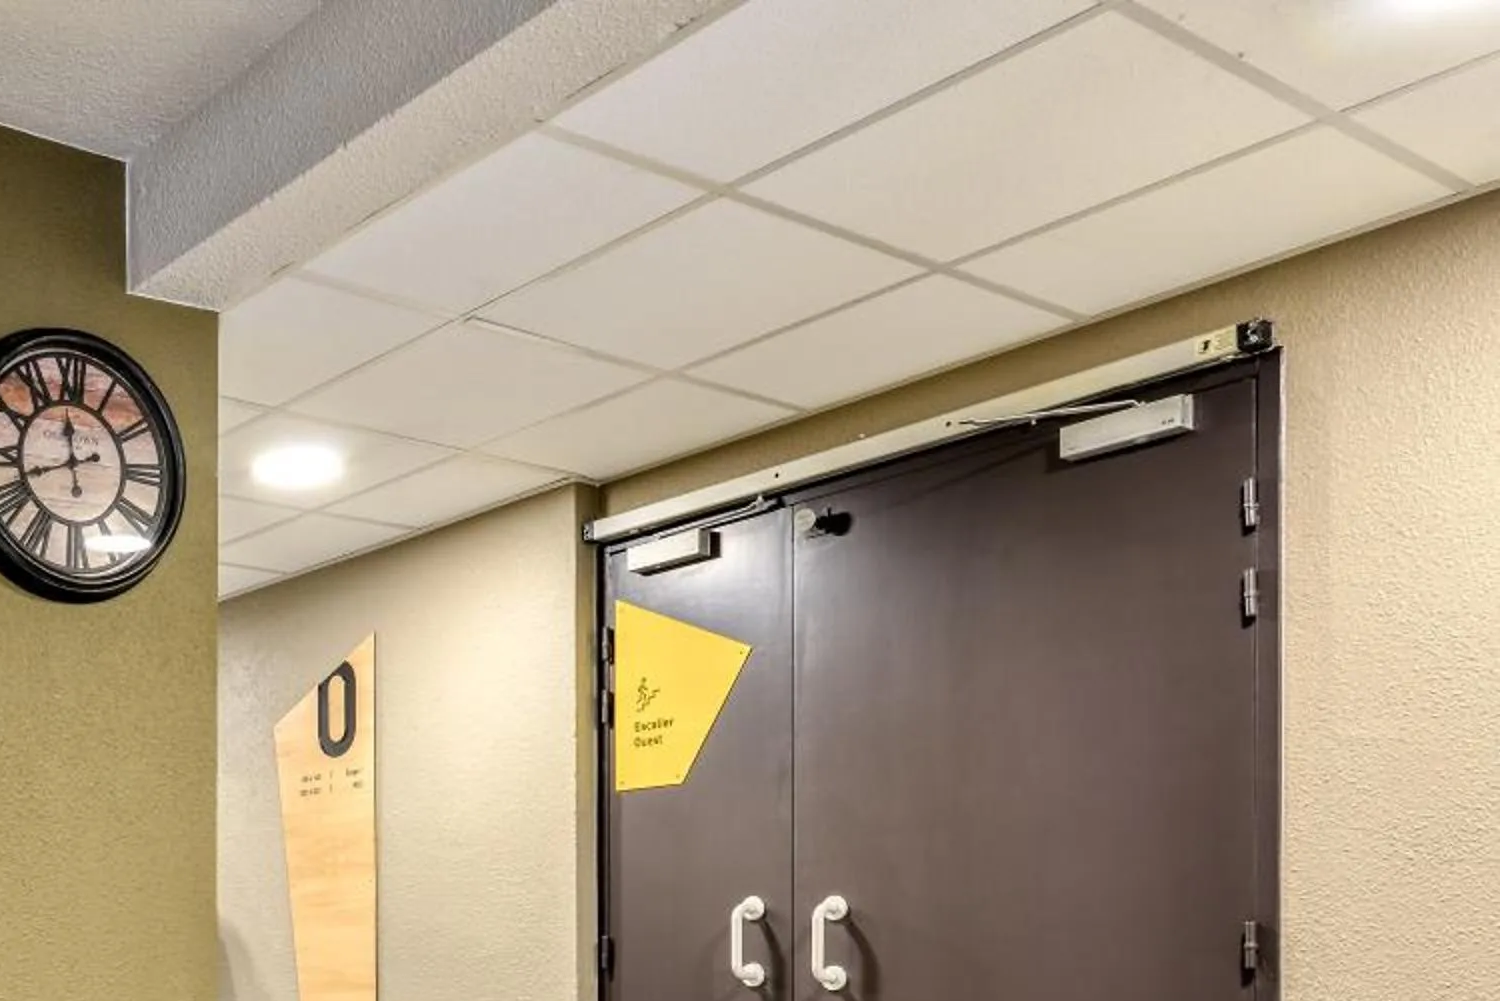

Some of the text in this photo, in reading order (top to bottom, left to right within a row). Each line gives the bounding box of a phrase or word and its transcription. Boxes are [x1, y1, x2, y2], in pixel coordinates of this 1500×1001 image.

[15, 361, 52, 410] XI
[56, 356, 86, 402] XII
[98, 377, 118, 412] I
[117, 415, 151, 443] II
[123, 462, 163, 487] III
[65, 524, 90, 569] VI
[634, 718, 674, 733] Escalier
